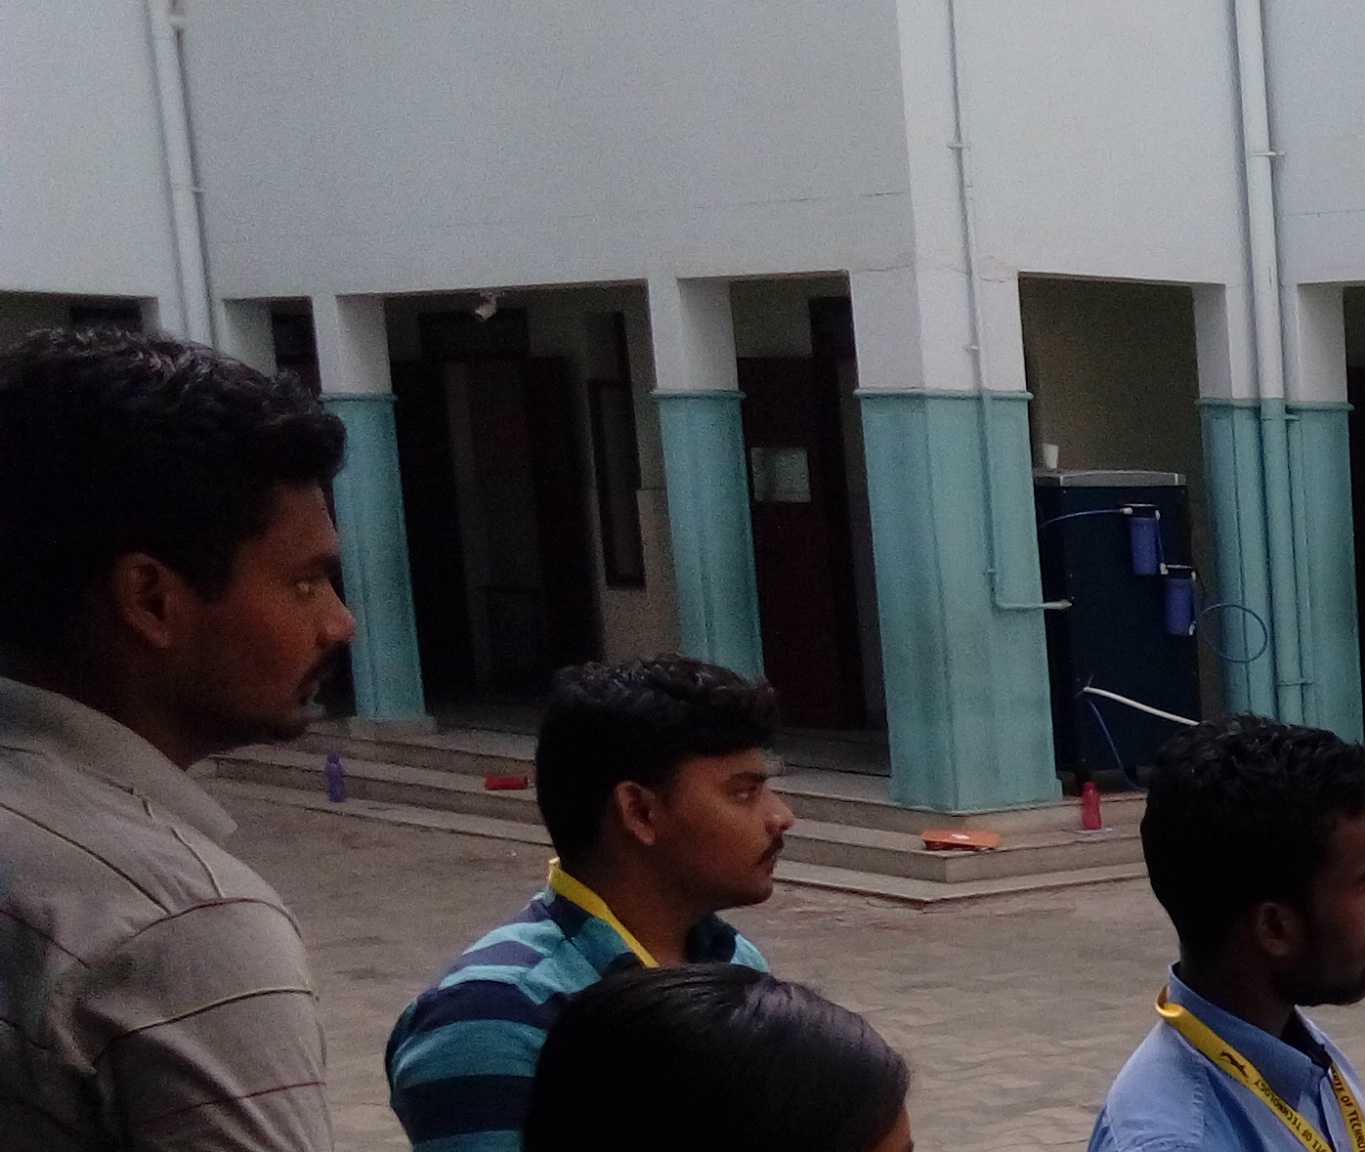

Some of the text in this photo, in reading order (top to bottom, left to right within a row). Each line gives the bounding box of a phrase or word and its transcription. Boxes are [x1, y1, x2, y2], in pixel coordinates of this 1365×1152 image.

[1253, 1079, 1302, 1132] TECHNOLOGY
[1340, 1094, 1353, 1108] OF
[1302, 1128, 1313, 1142] OF
